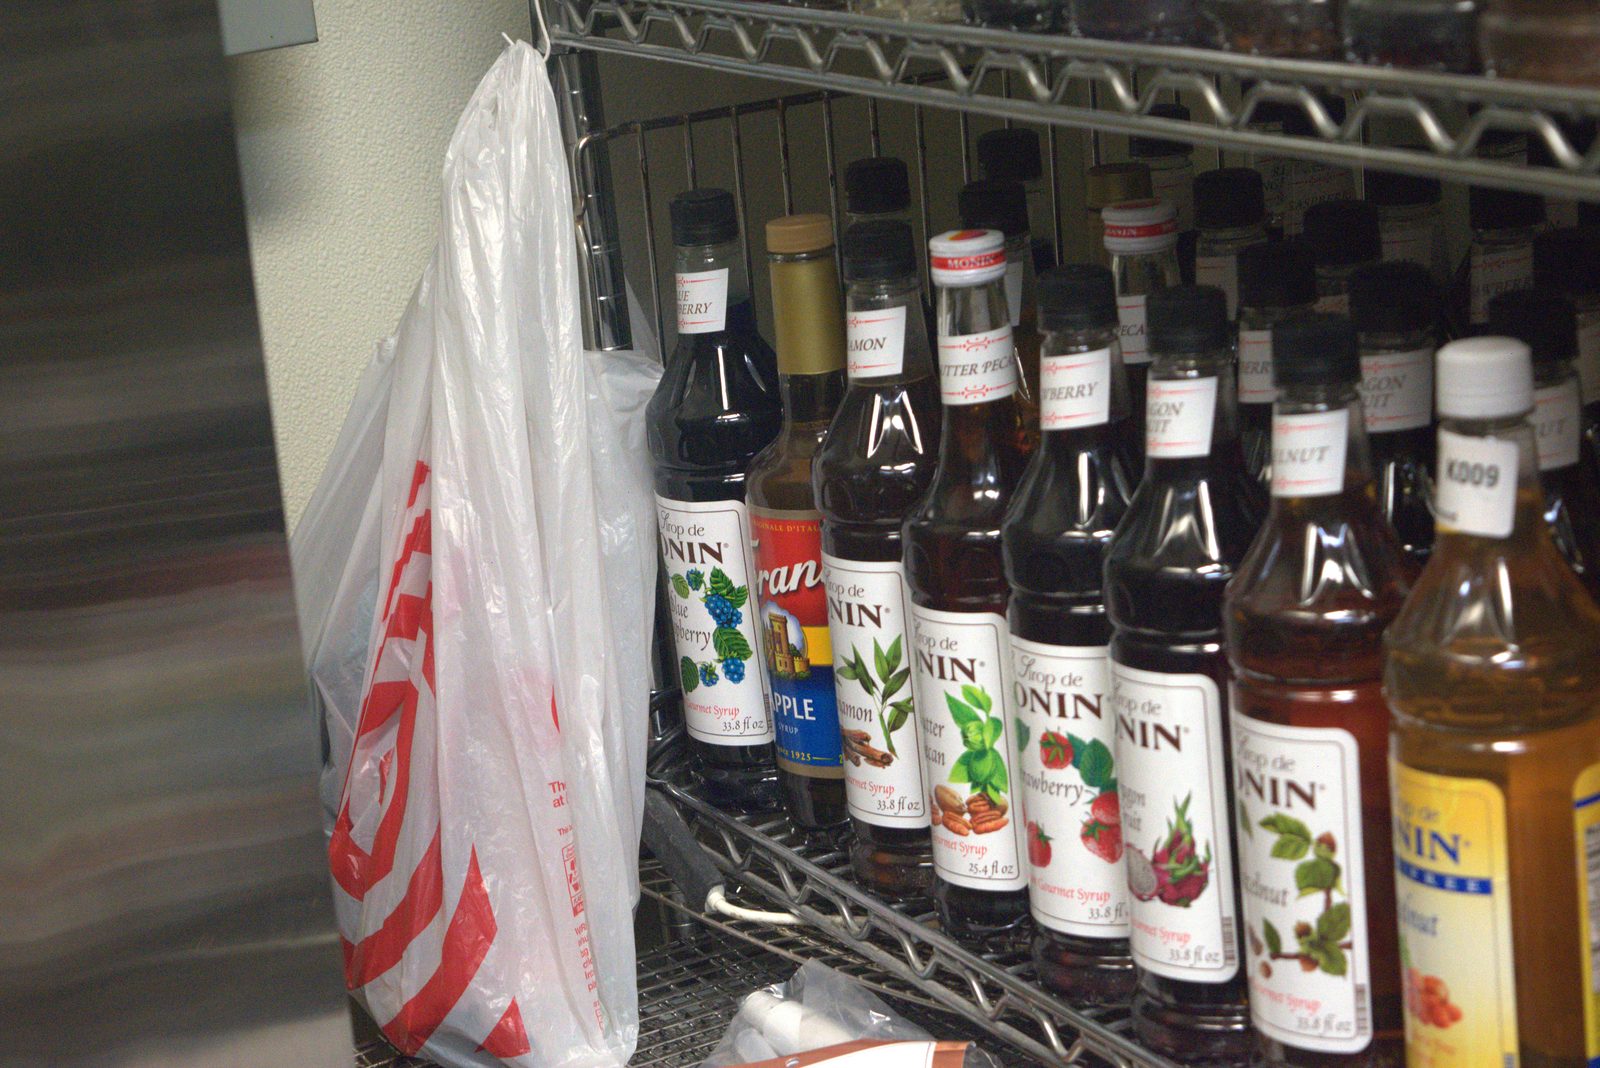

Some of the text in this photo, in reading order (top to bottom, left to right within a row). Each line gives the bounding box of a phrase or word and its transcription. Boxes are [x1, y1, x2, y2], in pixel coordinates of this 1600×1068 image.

[947, 255, 993, 270] MONIN
[940, 356, 1016, 378] UTTER PECA
[660, 509, 705, 539] Sirop de
[847, 584, 865, 598] de
[829, 596, 883, 629] NIN
[939, 636, 958, 652] de
[1018, 654, 1084, 693] Sirop de
[773, 691, 817, 721] PPLE
[1013, 680, 1104, 720] ONIN
[1140, 699, 1162, 716] de
[713, 705, 740, 720] Syrup
[722, 716, 764, 735] 33.8 fl oz
[791, 750, 811, 761] 1925
[868, 780, 895, 799] Syrup
[876, 796, 920, 815] 33.8 fl oz
[958, 842, 988, 860] Syrup
[968, 859, 1014, 878] 25.4 fl oz
[1037, 876, 1075, 899] Gourmet
[1076, 888, 1111, 908] Syrup
[1088, 906, 1112, 920] 33.8
[1110, 902, 1124, 924] fl
[1158, 925, 1192, 947] Syrup
